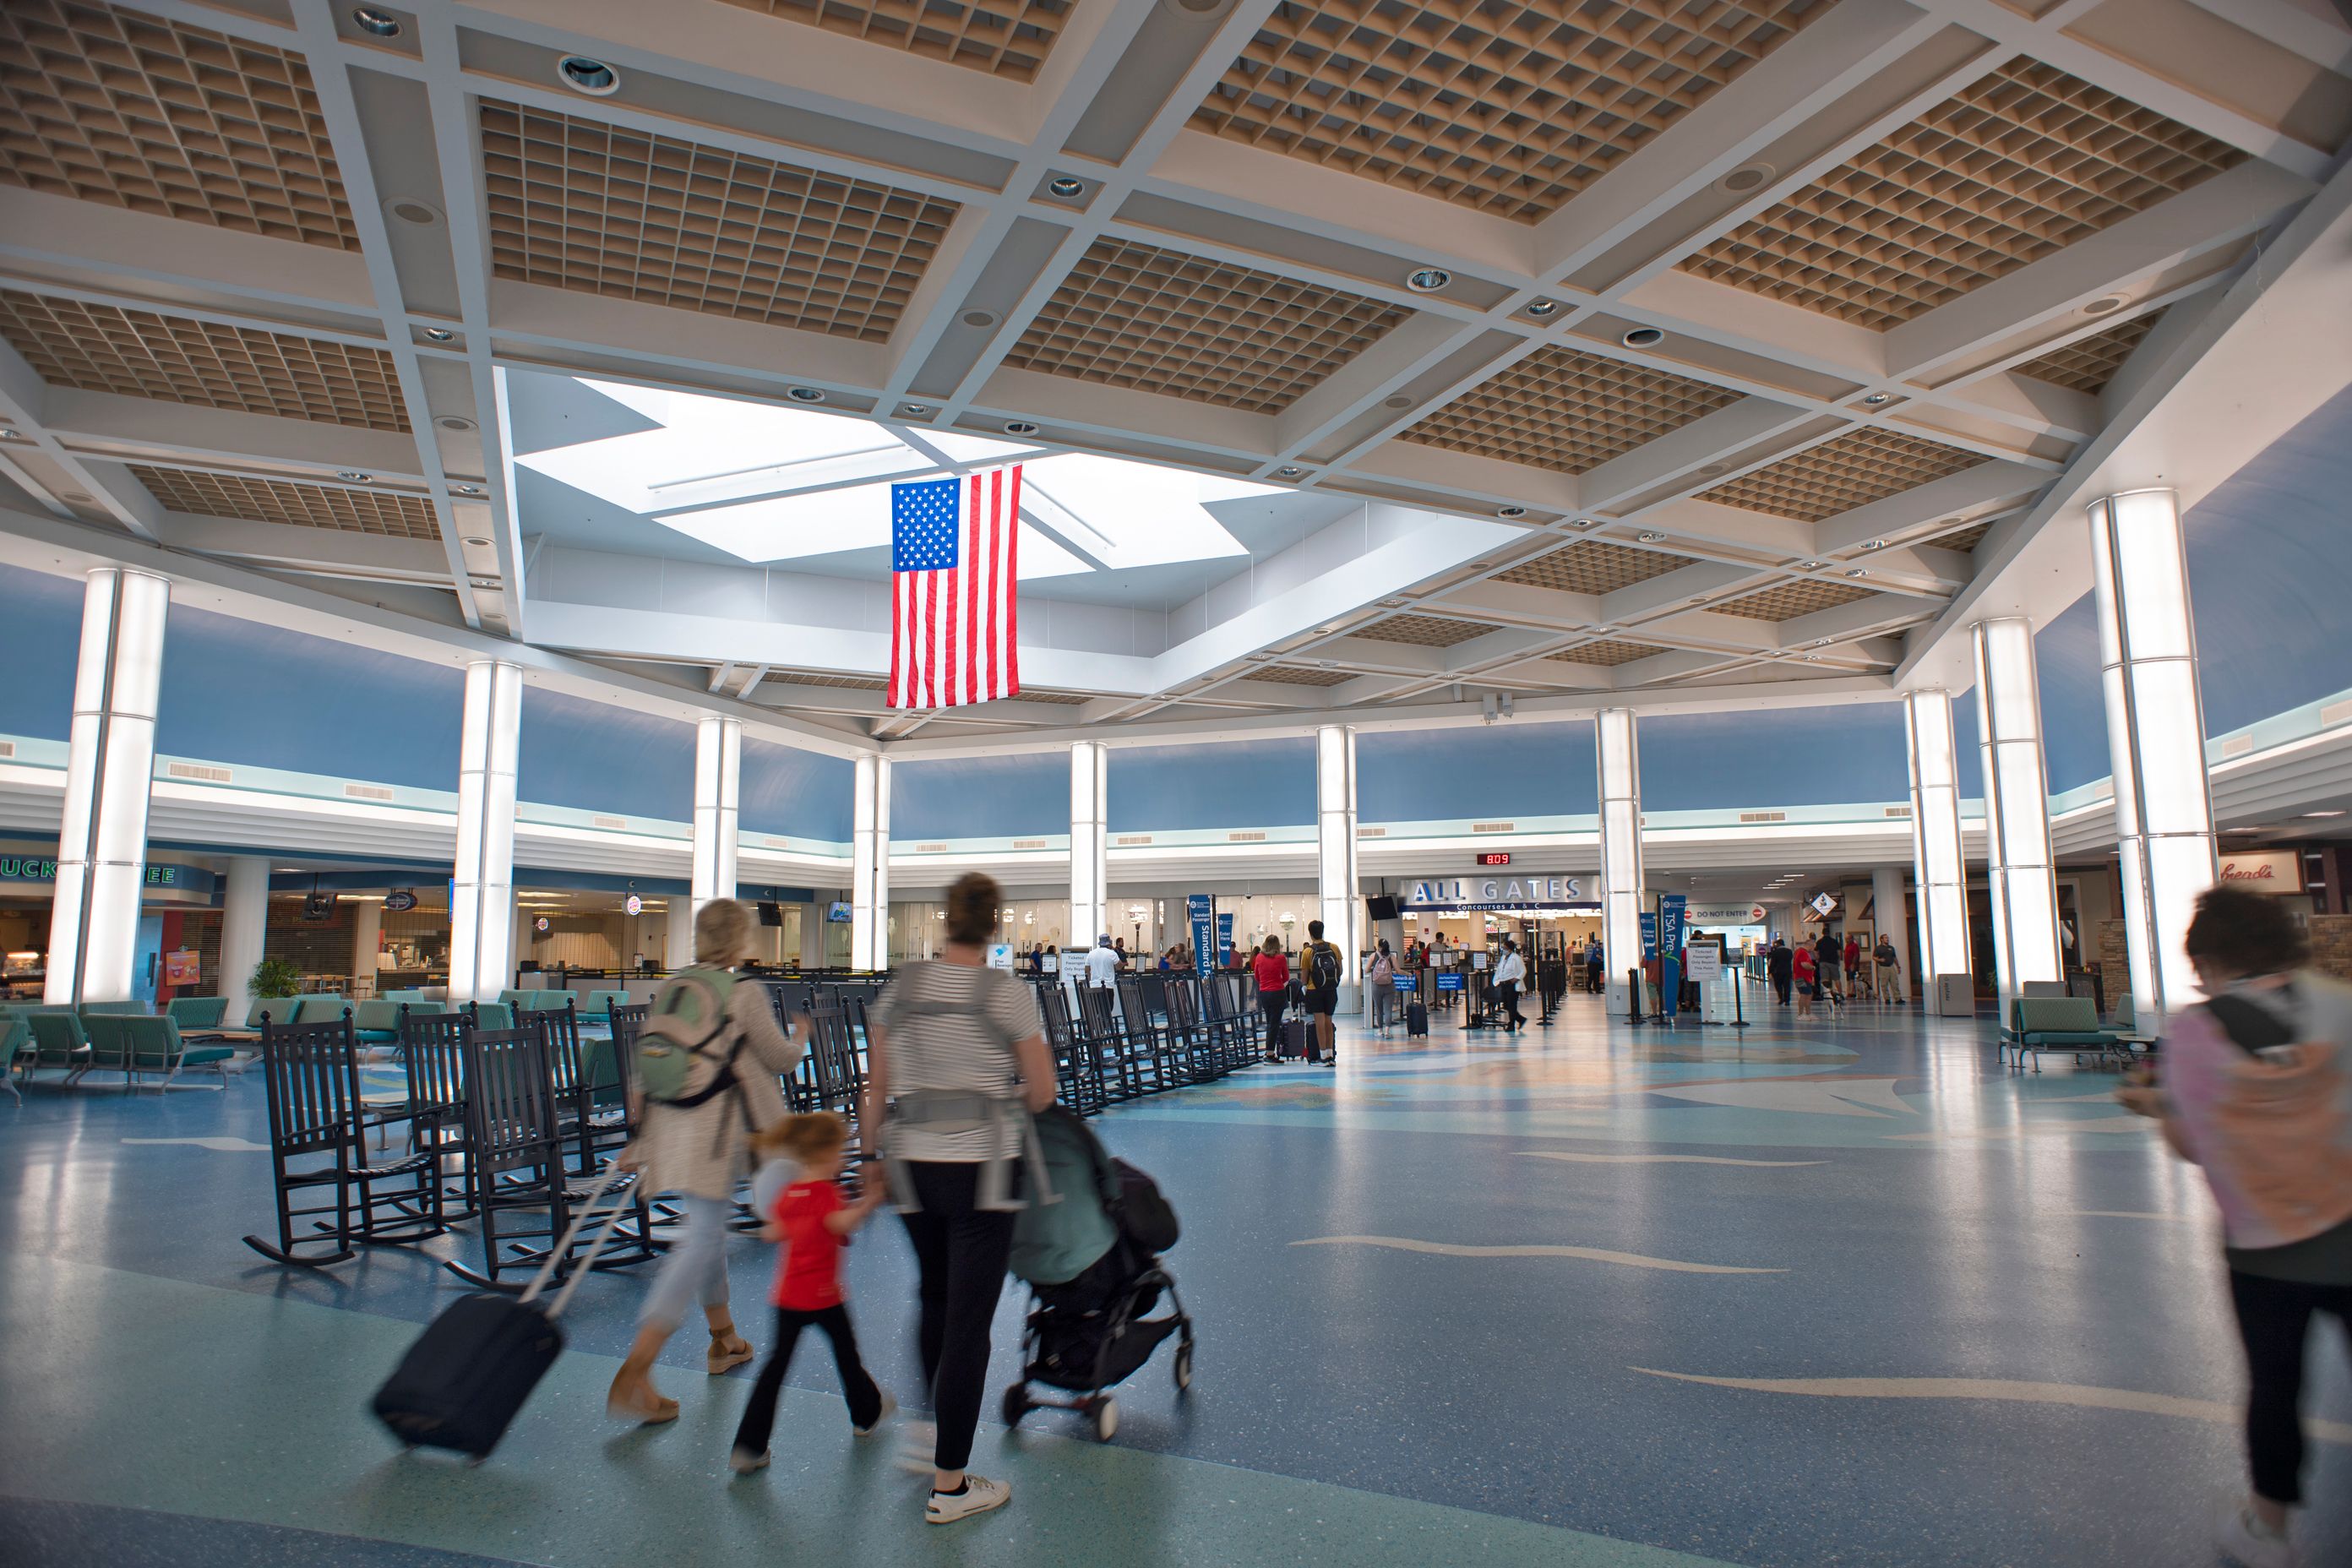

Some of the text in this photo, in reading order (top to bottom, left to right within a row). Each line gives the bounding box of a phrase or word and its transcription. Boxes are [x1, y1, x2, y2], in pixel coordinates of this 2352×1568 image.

[1413, 879, 1582, 902] ALL GATES
[1456, 903, 1505, 912] Concourses
[1201, 925, 1211, 967] Standard
[1665, 912, 1676, 951] TSA Pre
